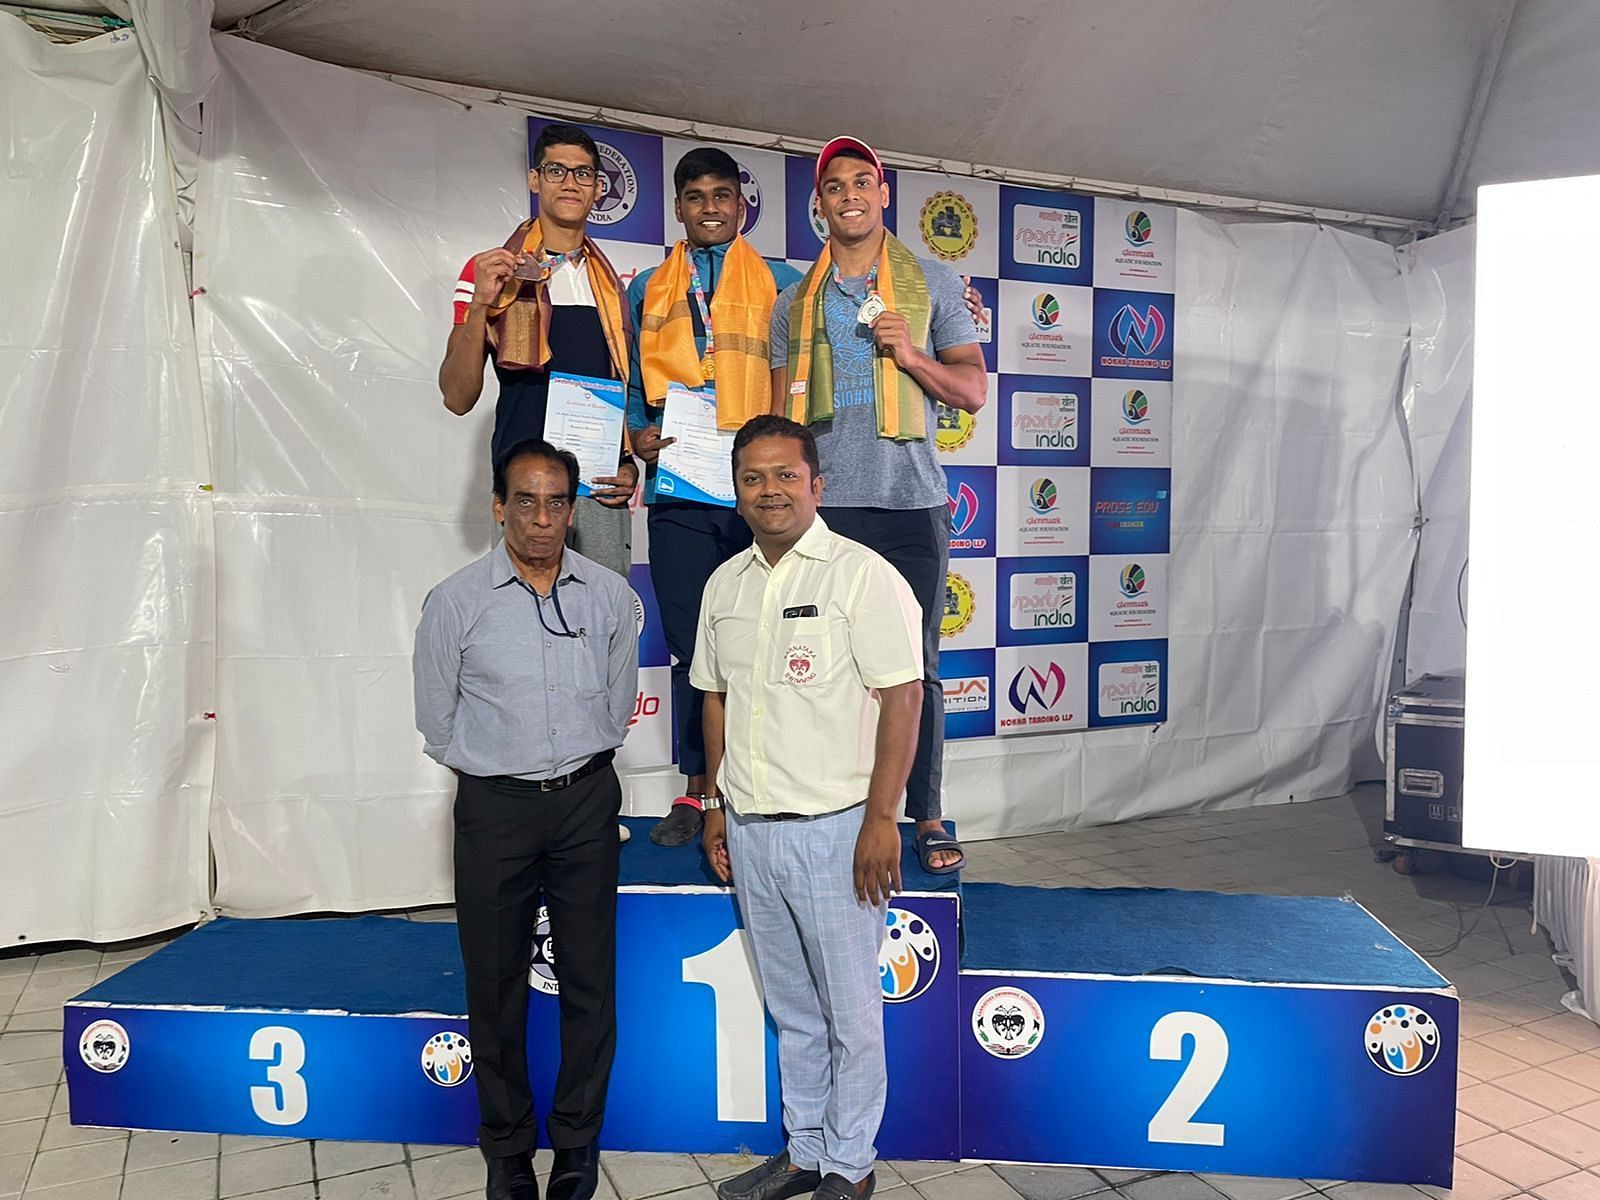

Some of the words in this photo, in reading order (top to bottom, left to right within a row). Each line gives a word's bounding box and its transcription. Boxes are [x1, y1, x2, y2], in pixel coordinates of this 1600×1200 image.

[599, 145, 635, 194] EDERATION
[589, 212, 612, 221] NDIA
[834, 388, 873, 408] SIO#N
[682, 929, 767, 1122] 1
[249, 1026, 308, 1125] 3
[1148, 1011, 1228, 1146] 2
